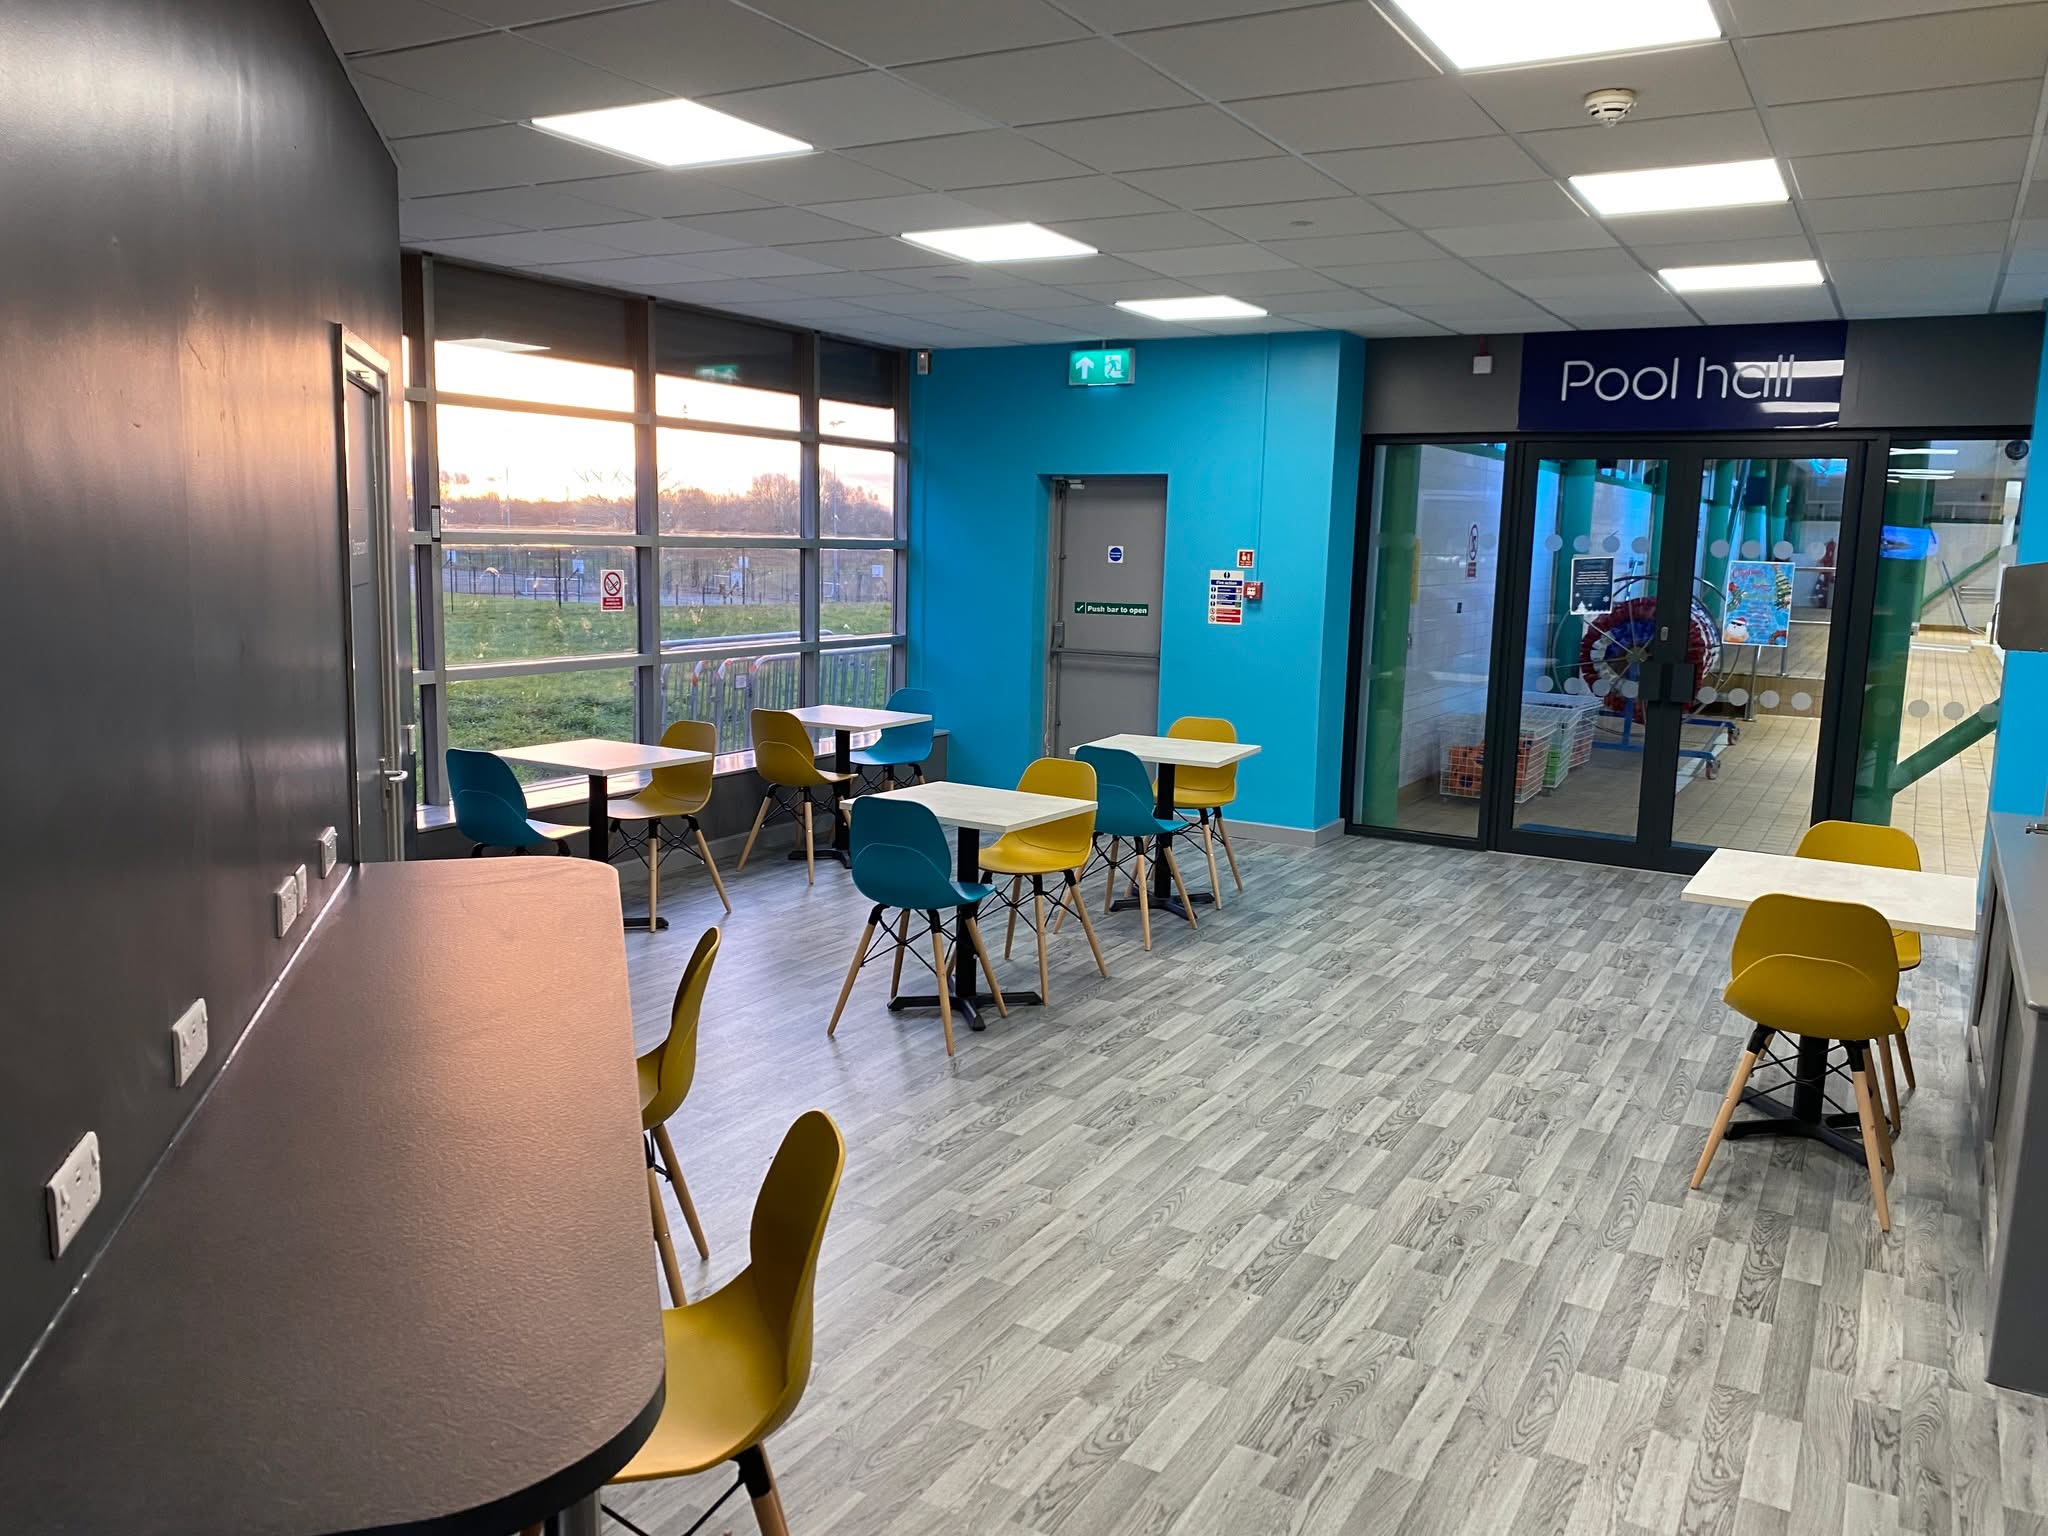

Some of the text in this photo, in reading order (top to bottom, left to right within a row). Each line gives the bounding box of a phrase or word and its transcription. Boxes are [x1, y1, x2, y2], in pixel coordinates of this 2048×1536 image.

[1561, 354, 1795, 401] Pool hall
[1087, 605, 1105, 613] Push
[1129, 607, 1148, 615] open
